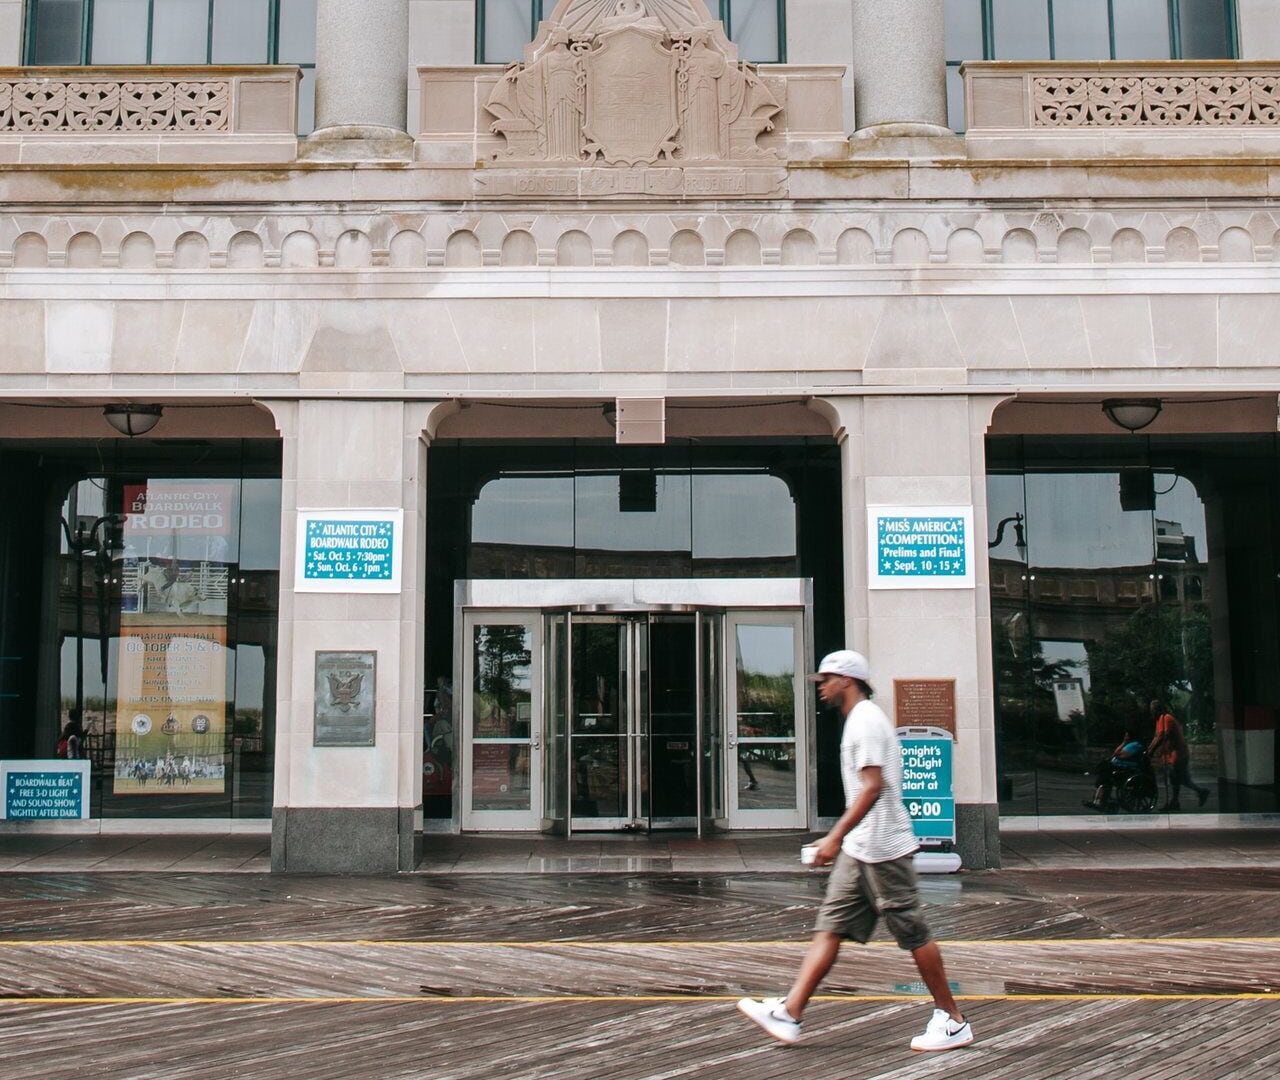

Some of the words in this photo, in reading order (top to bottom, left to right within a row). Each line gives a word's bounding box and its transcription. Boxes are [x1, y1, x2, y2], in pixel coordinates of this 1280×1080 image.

[136, 492, 190, 500] ATLANTIC
[193, 491, 220, 500] CITY
[131, 501, 224, 512] BOARDWALK
[131, 513, 224, 529] RODEO
[885, 521, 910, 532] MISS
[911, 521, 958, 532] AMERICA
[322, 524, 359, 536] ATLANTIC
[360, 524, 378, 536] CITY
[310, 537, 359, 548] BOARDWALK
[360, 537, 389, 549] RODEO
[885, 533, 958, 545] COMPETITION
[313, 551, 327, 561] Sat.
[328, 551, 344, 561] Oct.
[346, 551, 351, 561] 5
[357, 552, 385, 564] 7:30pm
[883, 547, 917, 558] Prelims
[919, 547, 937, 558] and
[938, 547, 961, 558] Final
[317, 562, 334, 572] Sun.
[335, 562, 351, 572] Oct.
[352, 563, 358, 572] 6
[363, 562, 380, 575] 1pm
[894, 560, 917, 574] Sept.
[921, 560, 932, 571] 10
[939, 560, 951, 571] 15
[193, 632, 217, 640] HALL
[126, 641, 181, 653] OCTOBER
[184, 641, 193, 652] 5
[903, 769, 937, 780] Shows
[15, 779, 57, 787] BOARDWALK
[58, 779, 74, 787] BEAT
[902, 780, 925, 790] start
[927, 781, 938, 790] at
[19, 789, 34, 797] FREE
[35, 789, 48, 797] 3-D
[49, 789, 69, 797] LIGHT
[12, 799, 27, 807] AND
[28, 799, 53, 807] SOUND
[54, 799, 76, 807] SHOW
[10, 809, 38, 817] NIGHTLY
[39, 809, 59, 817] AFTER
[60, 809, 78, 817] DARK
[909, 802, 941, 816] 9:00
